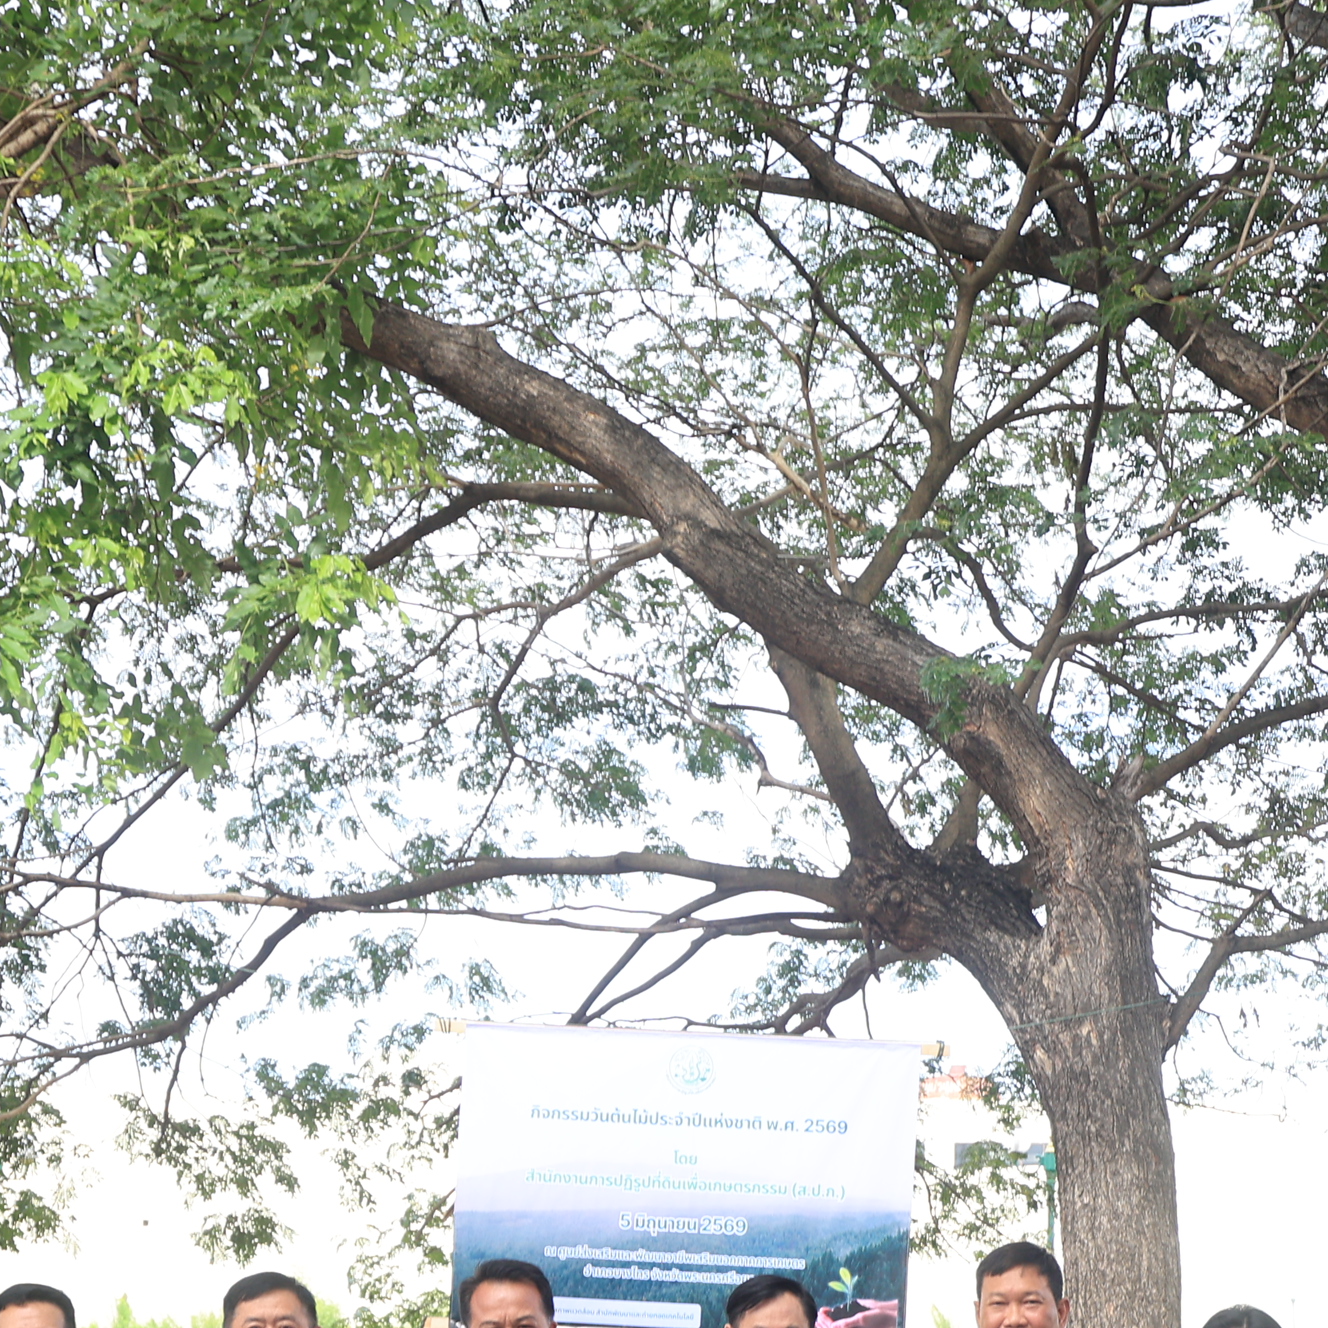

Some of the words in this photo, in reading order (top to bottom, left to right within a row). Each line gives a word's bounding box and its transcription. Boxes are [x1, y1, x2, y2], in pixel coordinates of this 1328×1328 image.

[531, 1105, 762, 1130] กิจกรรมวันต้นไม้ประจำปีแห่งชาติ
[767, 1119, 799, 1132] พ.ศ.
[804, 1118, 848, 1134] 2569
[674, 1150, 698, 1165] โดย
[526, 1168, 787, 1195] สำนักงานการปฏิรูปที่ดินเพื่อเกษตรกรรม
[792, 1183, 845, 1200] (ส.ป.ก.)
[619, 1212, 632, 1230] 5
[634, 1213, 698, 1236] มิถุนายน
[700, 1215, 748, 1236] 2569
